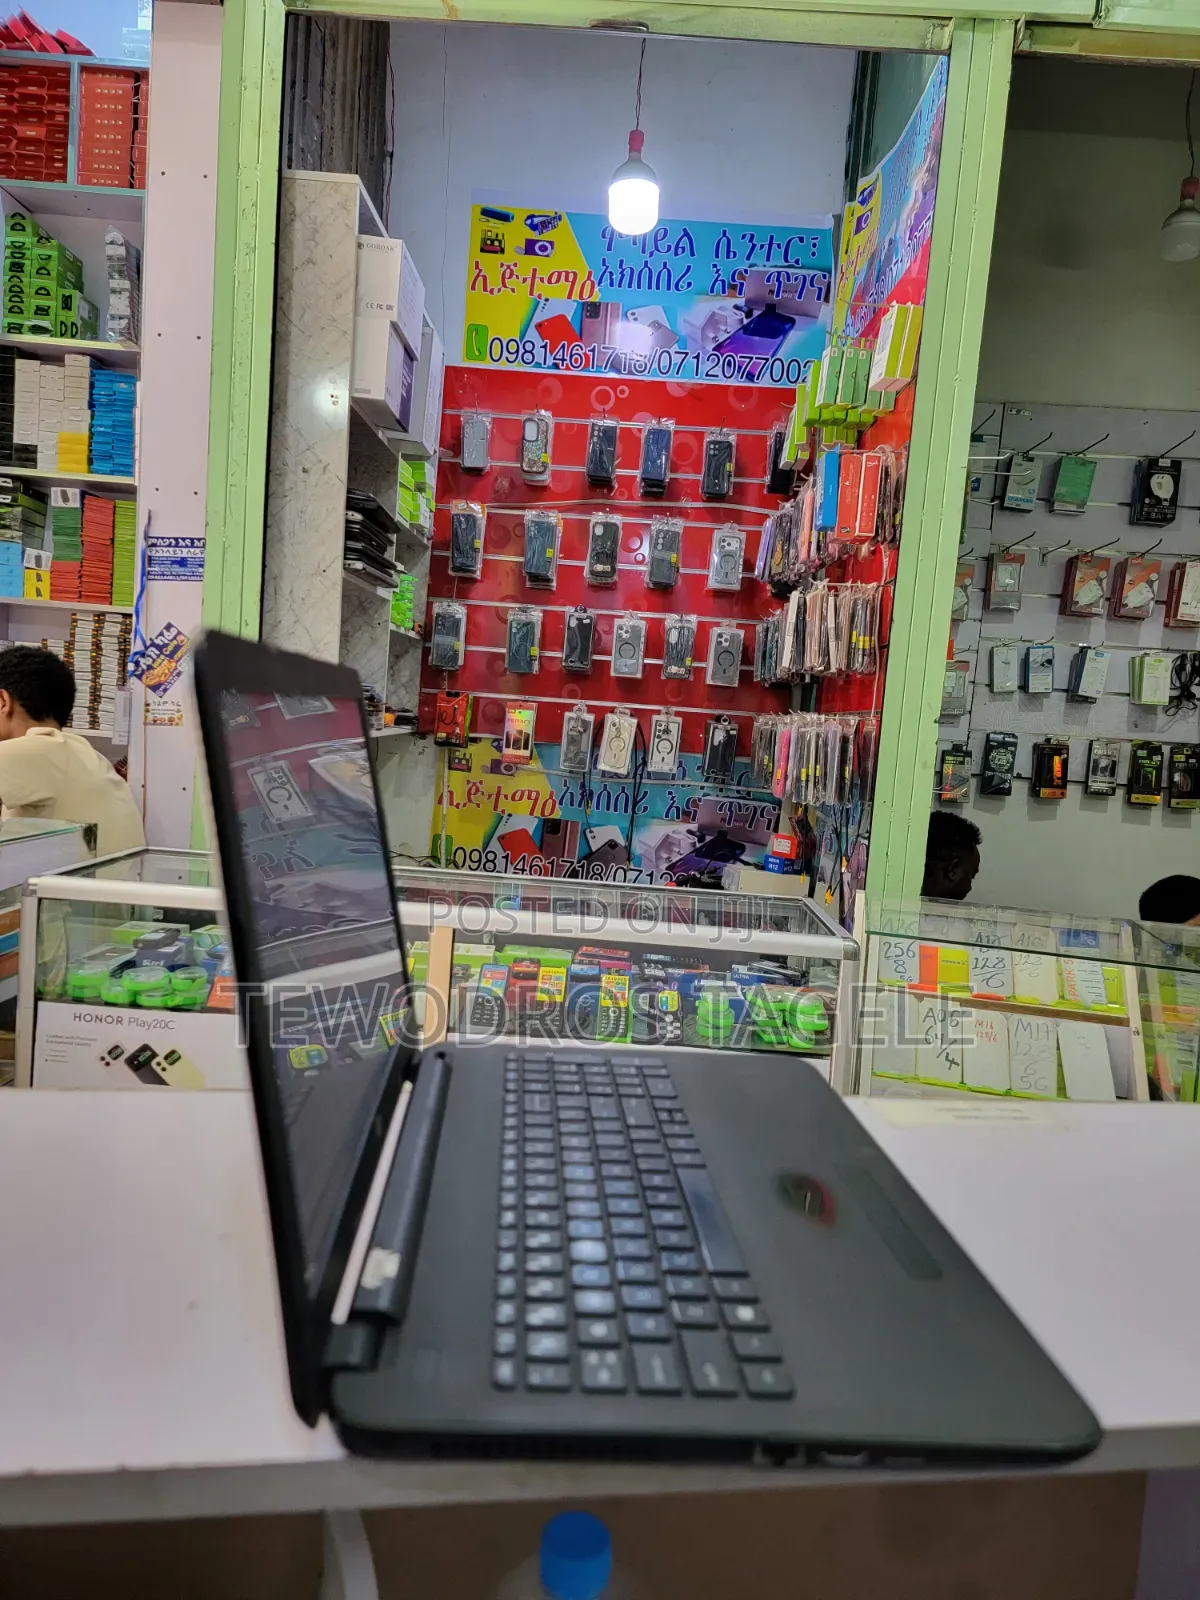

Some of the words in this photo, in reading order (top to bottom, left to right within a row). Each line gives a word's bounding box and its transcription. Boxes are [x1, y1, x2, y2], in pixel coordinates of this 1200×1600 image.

[709, 263, 749, 298] እና
[765, 270, 830, 302] ጥገና
[664, 790, 704, 823] እና
[883, 940, 916, 959] 256
[894, 960, 907, 974] 8
[73, 1012, 124, 1026] HONOR
